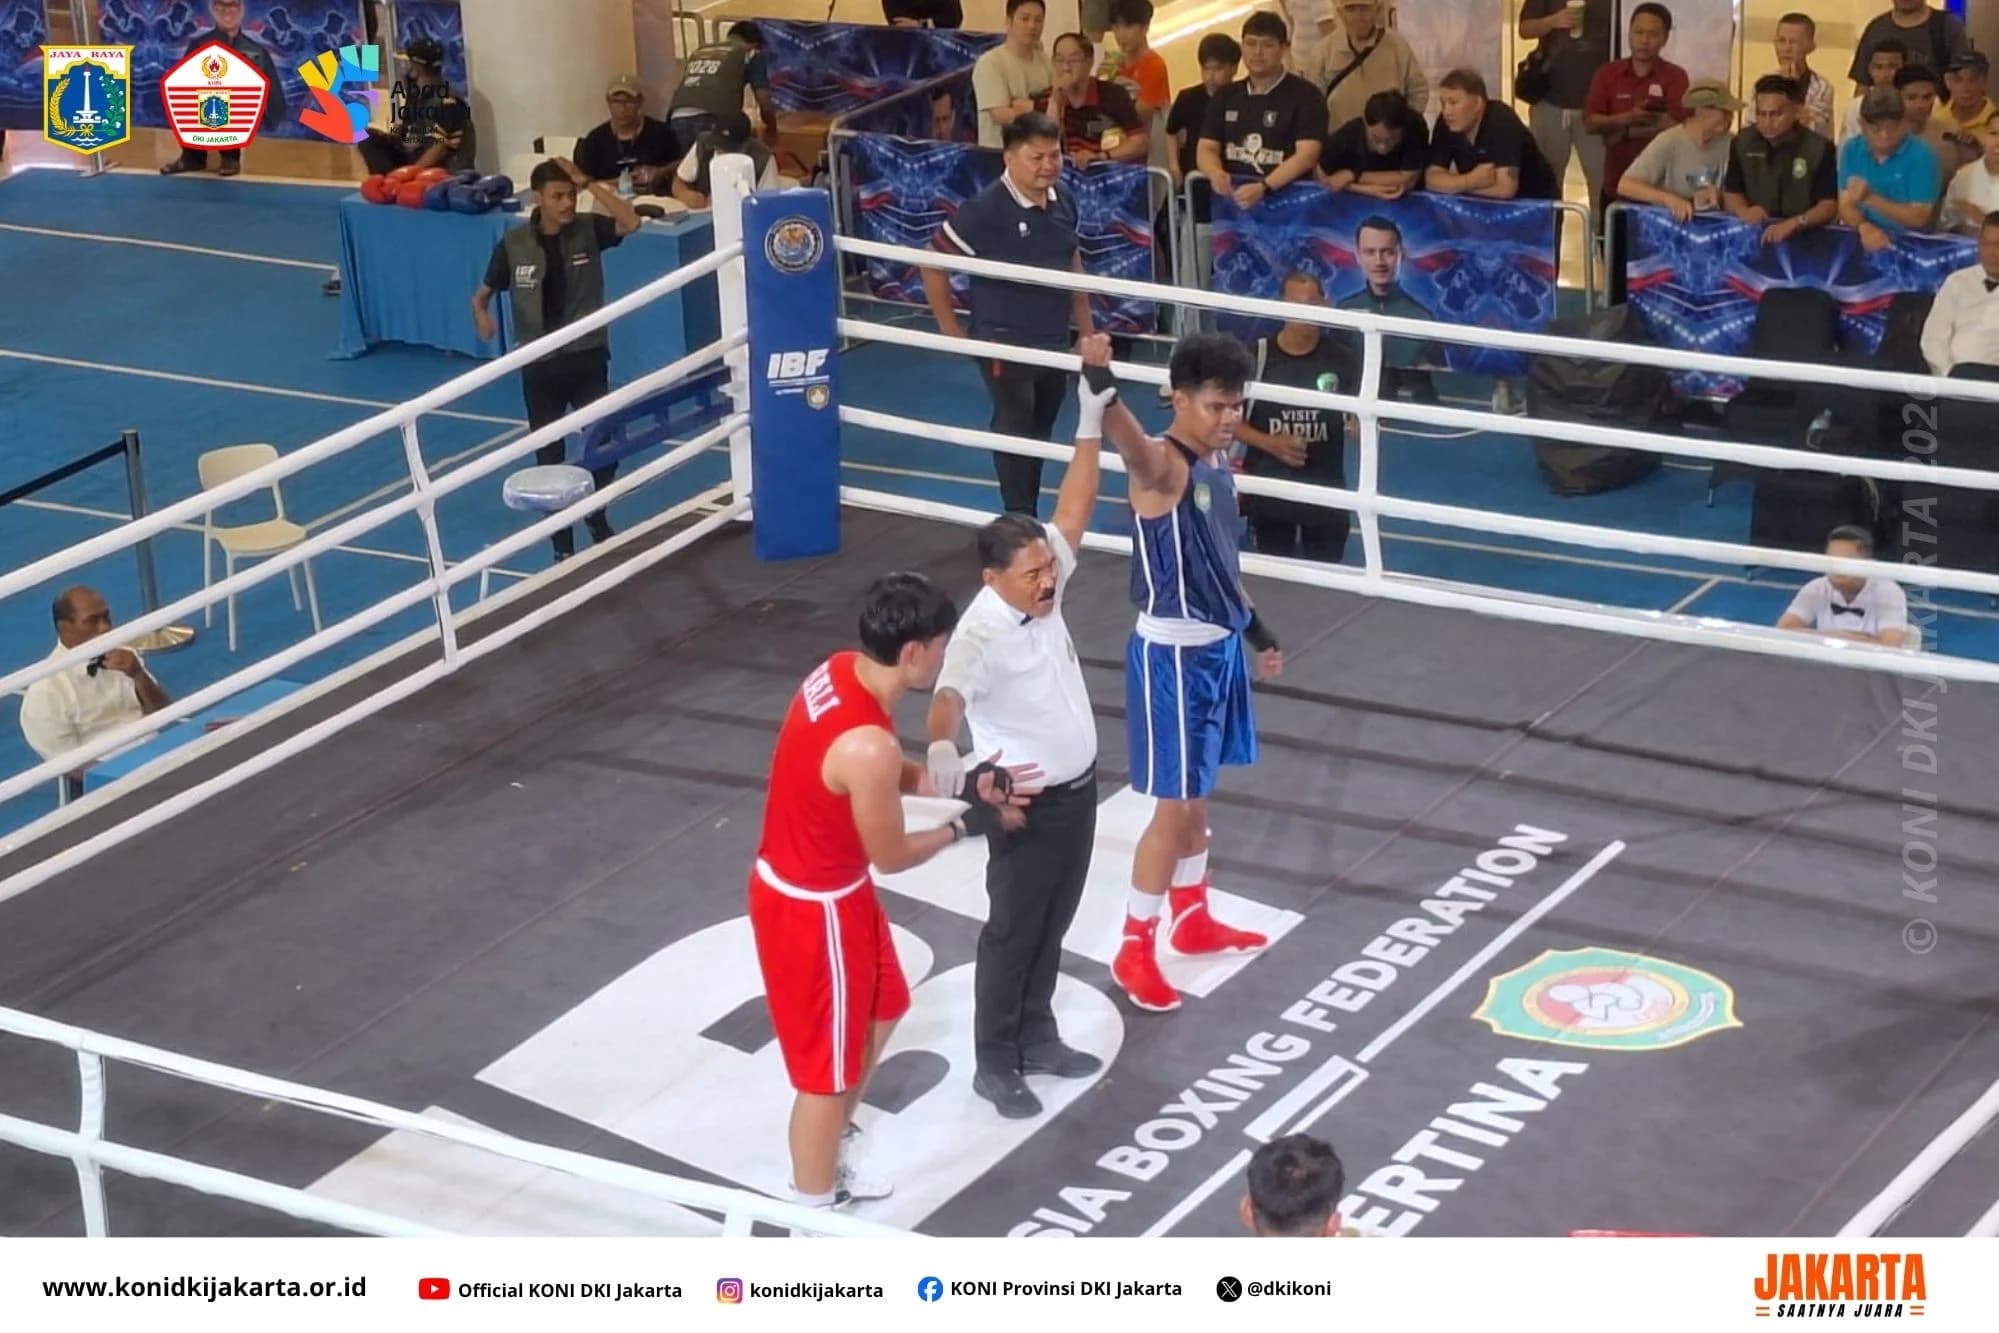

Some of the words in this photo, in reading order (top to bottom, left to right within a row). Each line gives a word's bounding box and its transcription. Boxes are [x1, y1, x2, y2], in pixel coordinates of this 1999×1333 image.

[767, 348, 829, 379] IBF
[1281, 409, 1320, 421] VISIT
[1269, 417, 1329, 442] PAPUA
[1095, 1030, 1311, 1181] BOXING
[1301, 823, 1569, 1033] FEDERATION
